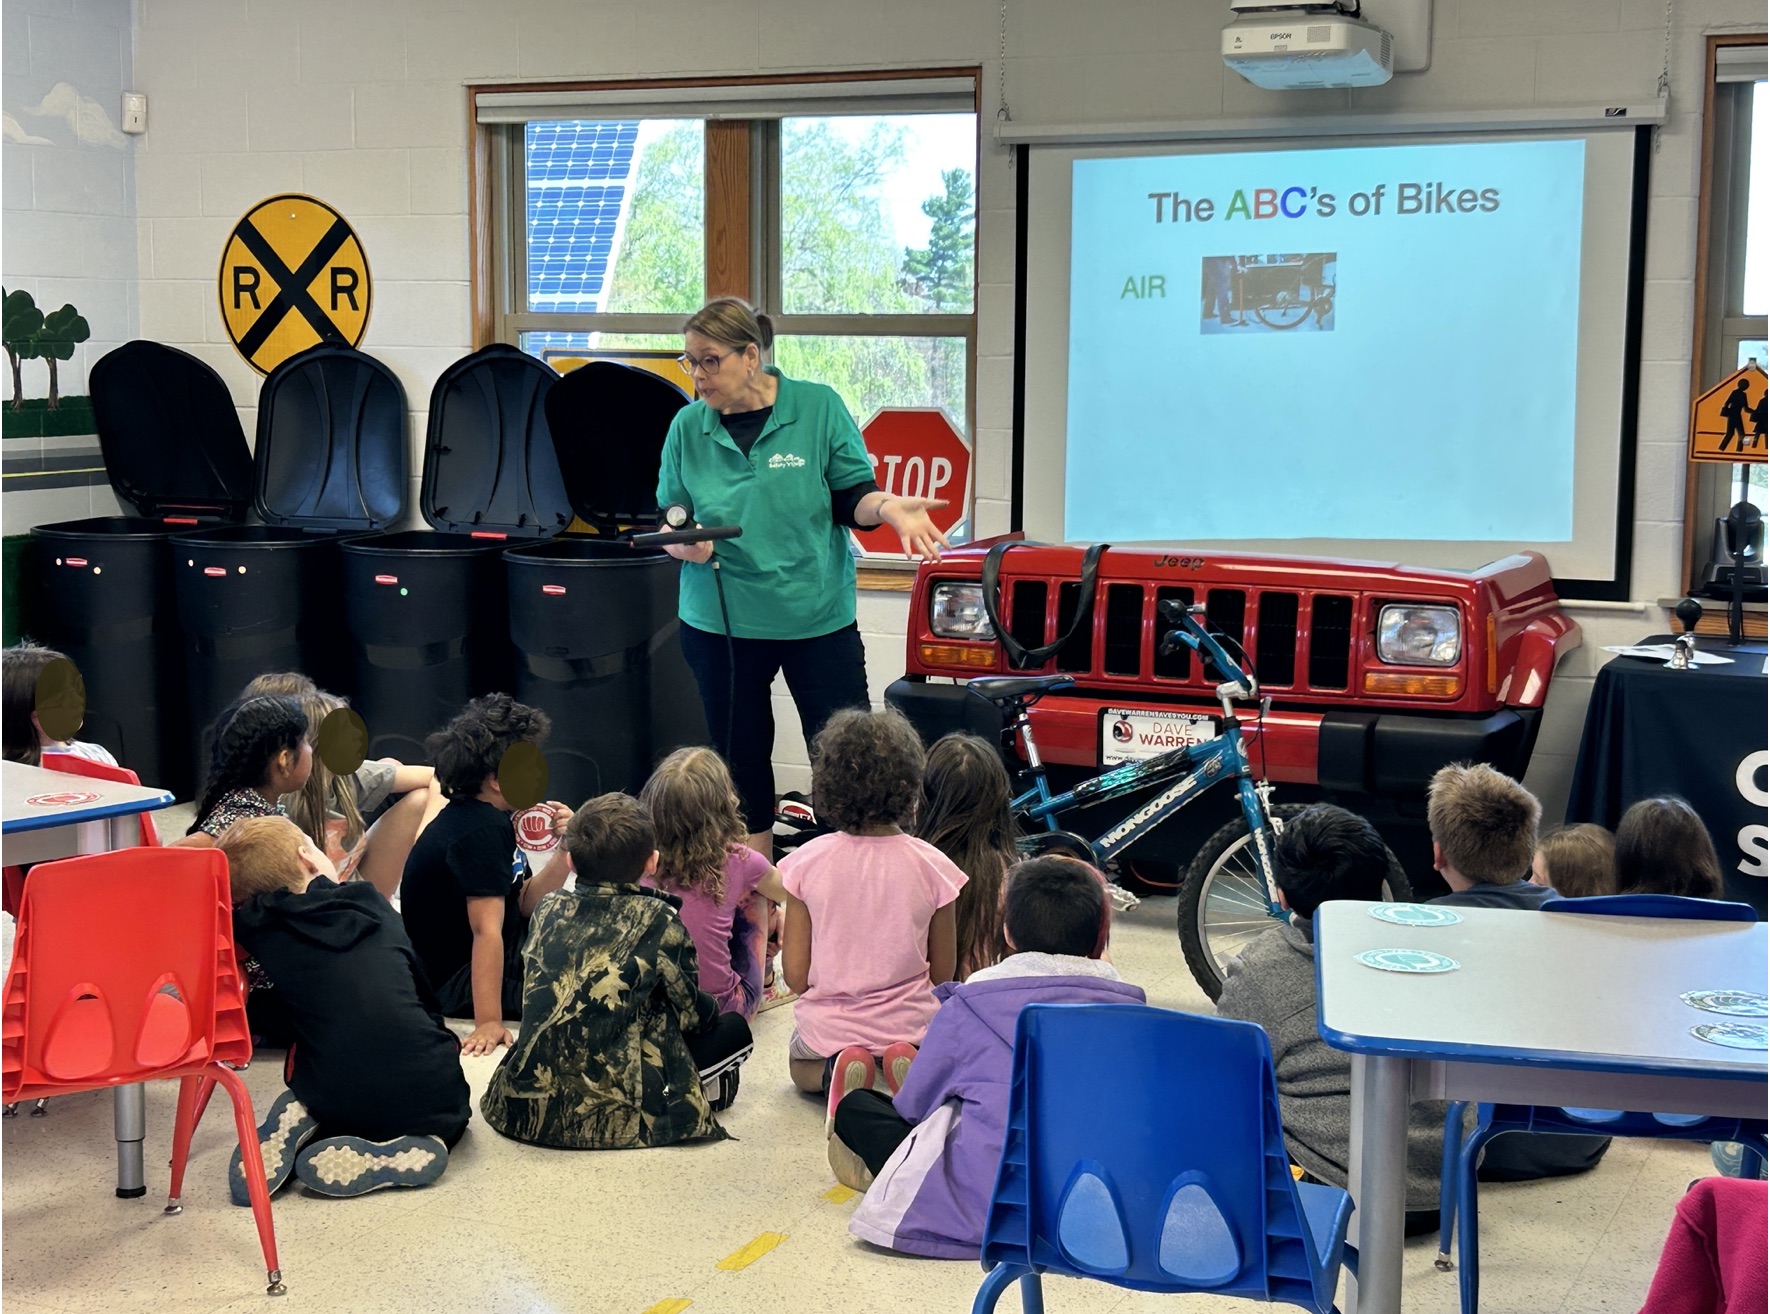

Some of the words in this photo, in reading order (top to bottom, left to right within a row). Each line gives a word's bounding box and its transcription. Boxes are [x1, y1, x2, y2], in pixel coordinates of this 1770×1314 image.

[1270, 32, 1292, 40] EPSON
[1148, 192, 1215, 224] The
[1348, 184, 1386, 217] of
[1397, 182, 1500, 214] Bikes
[1121, 275, 1166, 300] AIR
[1153, 554, 1205, 571] Jeep
[1153, 721, 1193, 736] DAVE
[1100, 774, 1198, 848] MONGOOSE
